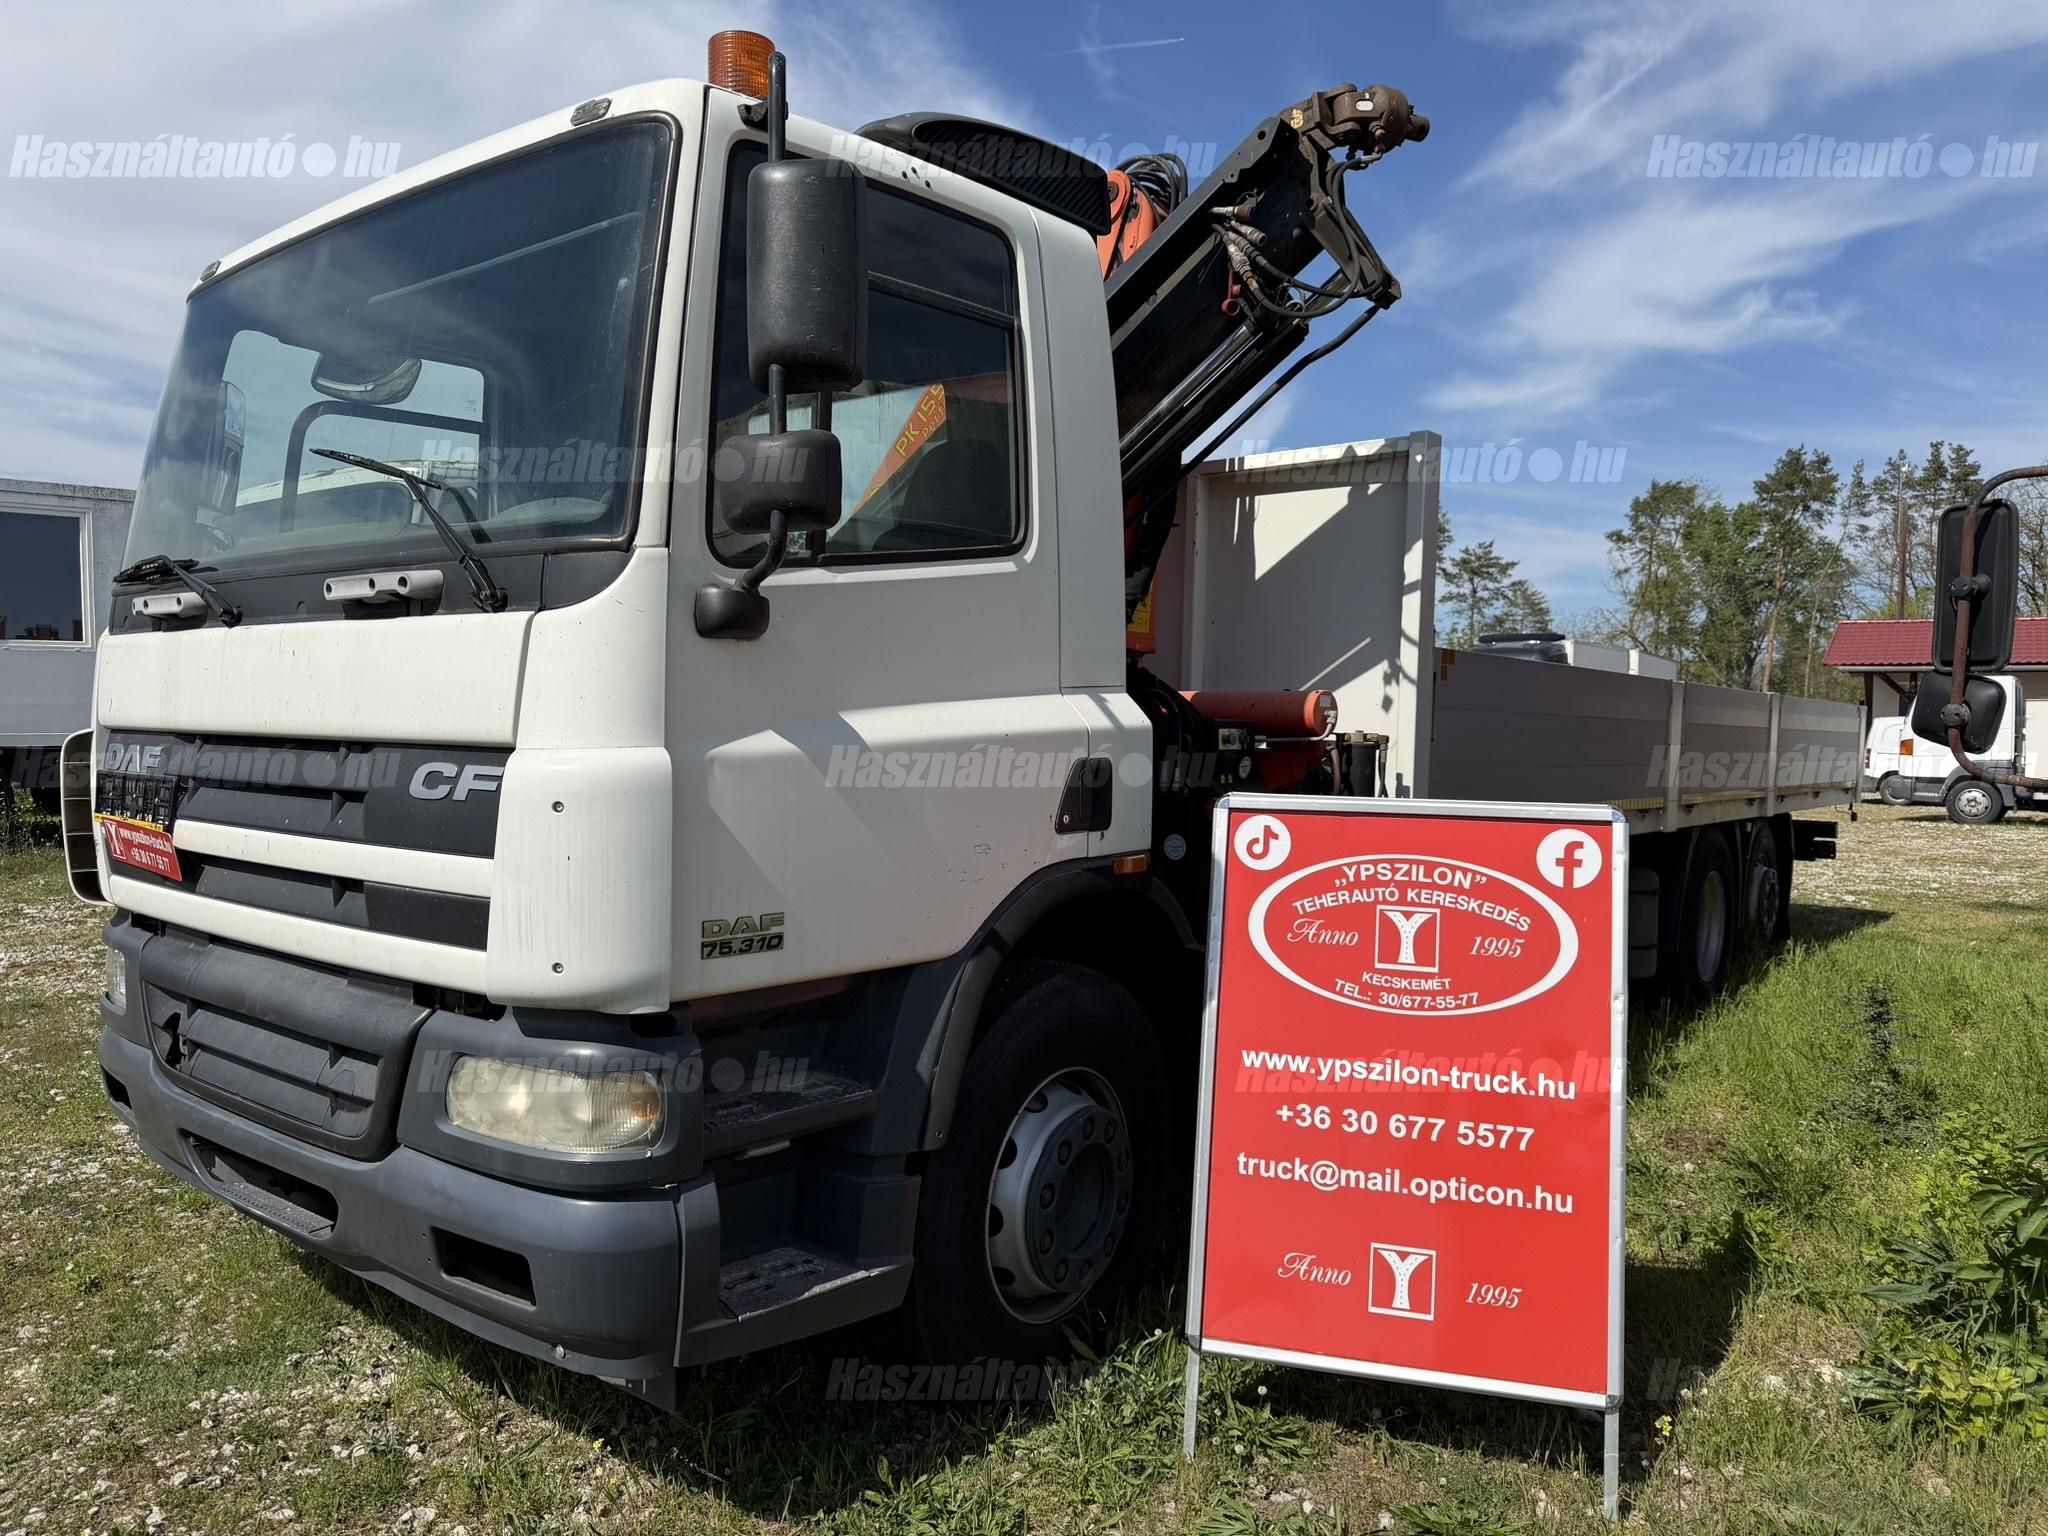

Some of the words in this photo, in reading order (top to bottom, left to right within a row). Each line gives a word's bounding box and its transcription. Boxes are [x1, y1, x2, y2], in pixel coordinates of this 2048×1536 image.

[895, 422, 920, 456] PK
[104, 742, 162, 775] DAF
[409, 762, 504, 801] CF
[702, 911, 784, 939] DAF
[1292, 884, 1400, 915] TEHERAUTÓ
[1406, 888, 1531, 932] KERESKEDÉS
[702, 934, 784, 959] 75.310
[1287, 918, 1359, 946] Anno
[1469, 935, 1525, 958] 1995
[1334, 978, 1372, 1001] TEL.:
[1378, 992, 1479, 1008] 30/677-55-77
[1362, 971, 1451, 990] KECSKEMÉT
[1241, 1049, 1576, 1100] www.ypszilon-truck.hu
[1275, 1103, 1331, 1130] +36
[1342, 1108, 1378, 1135] 30
[1389, 1114, 1446, 1142] 677
[1456, 1122, 1535, 1151] 5577
[1237, 1151, 1574, 1214] truck@mail.opticon.hu
[1276, 1252, 1352, 1287] Anno
[1465, 1282, 1522, 1309] 1995
